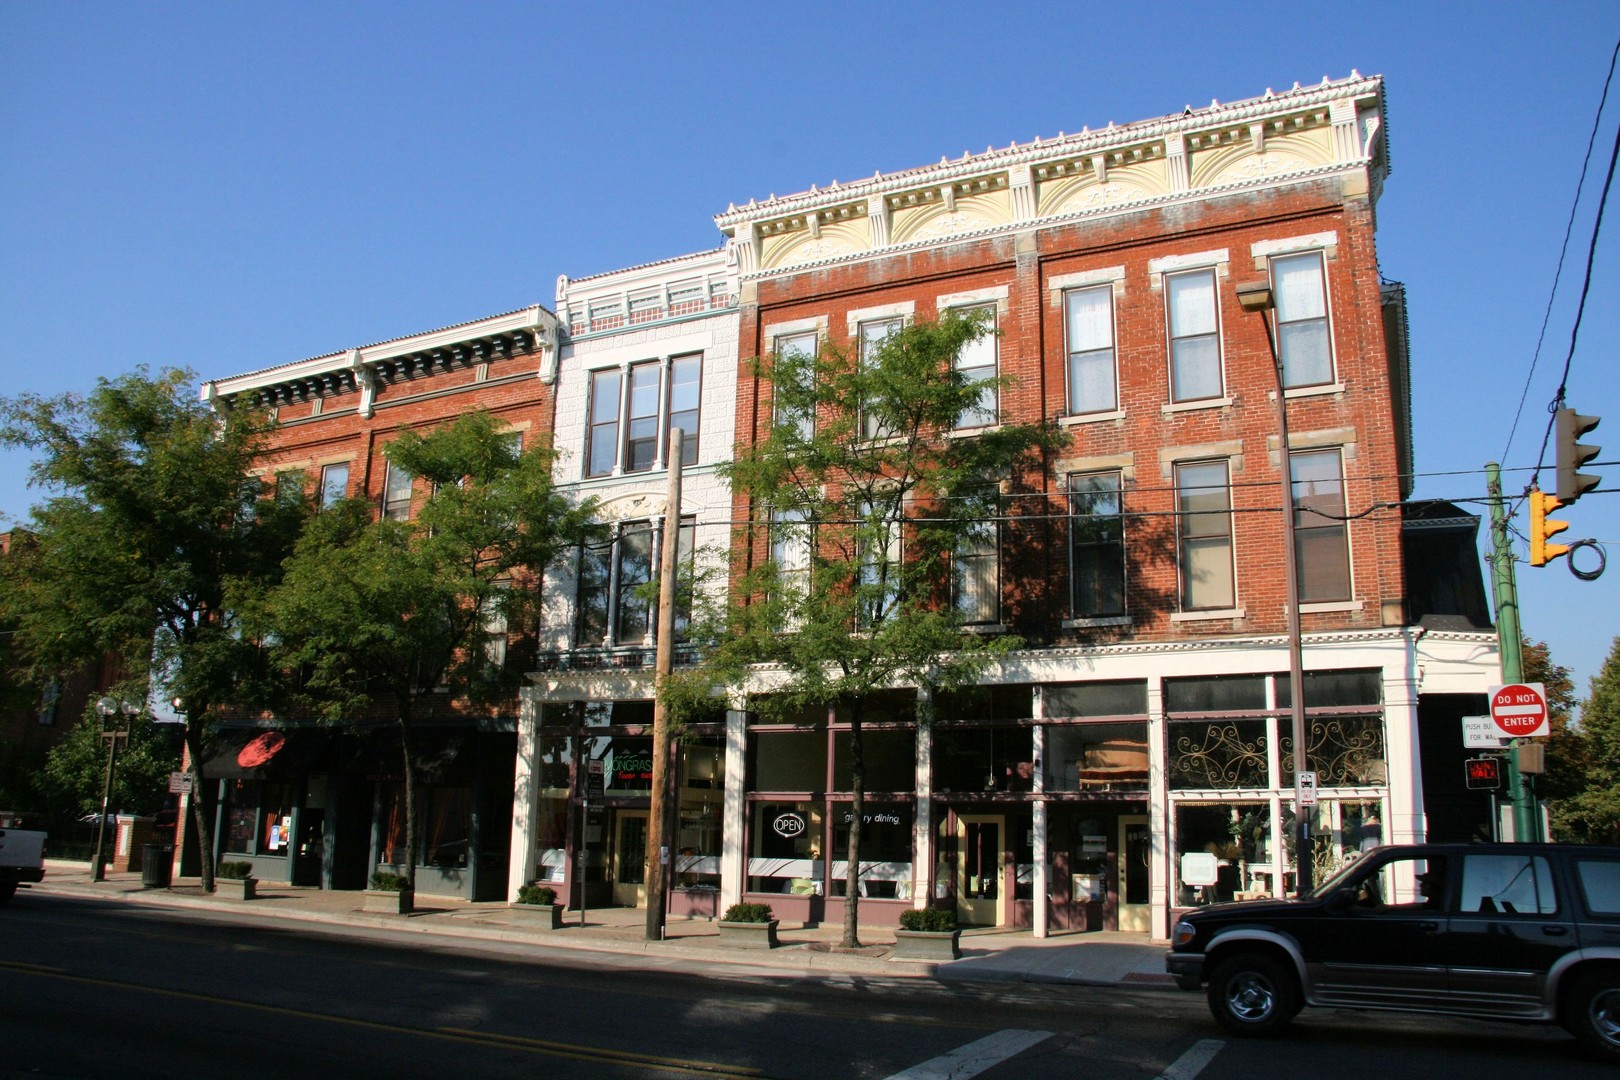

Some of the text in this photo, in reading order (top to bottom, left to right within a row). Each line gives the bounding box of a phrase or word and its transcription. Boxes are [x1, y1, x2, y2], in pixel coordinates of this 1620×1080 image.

[1498, 694, 1535, 704] DO NOT
[1504, 717, 1535, 726] ENTER
[1470, 770, 1496, 778] WALK
[844, 814, 900, 824] gary dining
[776, 819, 801, 831] OPEN
